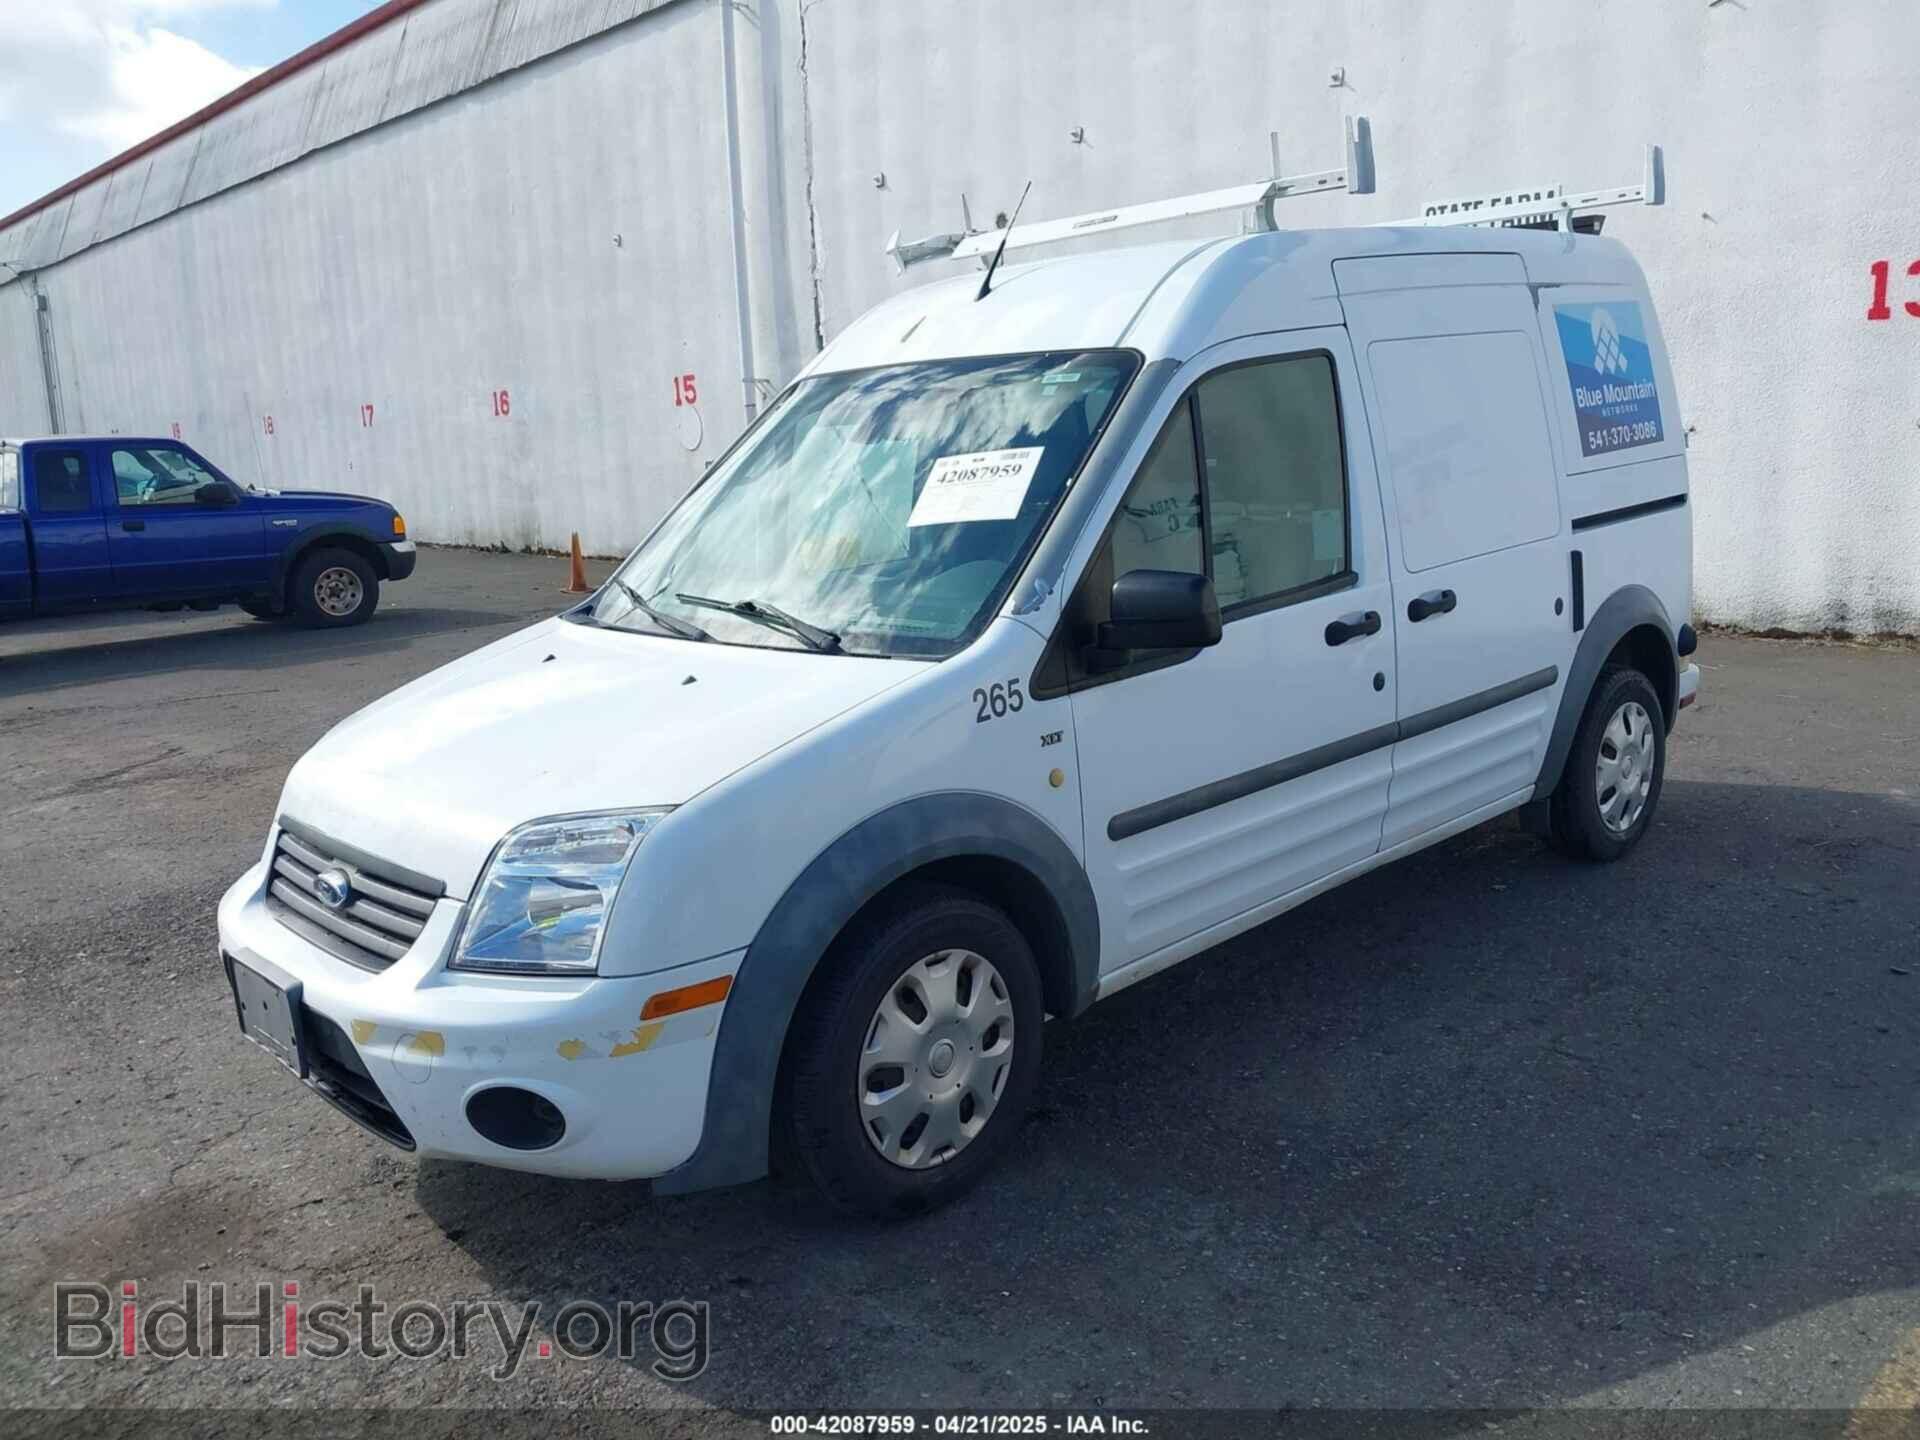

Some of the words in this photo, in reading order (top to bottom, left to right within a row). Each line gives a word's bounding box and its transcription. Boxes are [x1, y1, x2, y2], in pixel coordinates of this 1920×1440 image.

[493, 390, 510, 417] 16
[674, 374, 697, 407] 15
[1575, 385, 1602, 408] Blue
[1602, 379, 1656, 403] Mountain
[263, 415, 274, 434] 18
[361, 404, 374, 427] 17
[1588, 421, 1657, 449] 541-370-3086
[937, 463, 1022, 484] 42087959
[972, 678, 1024, 723] 265
